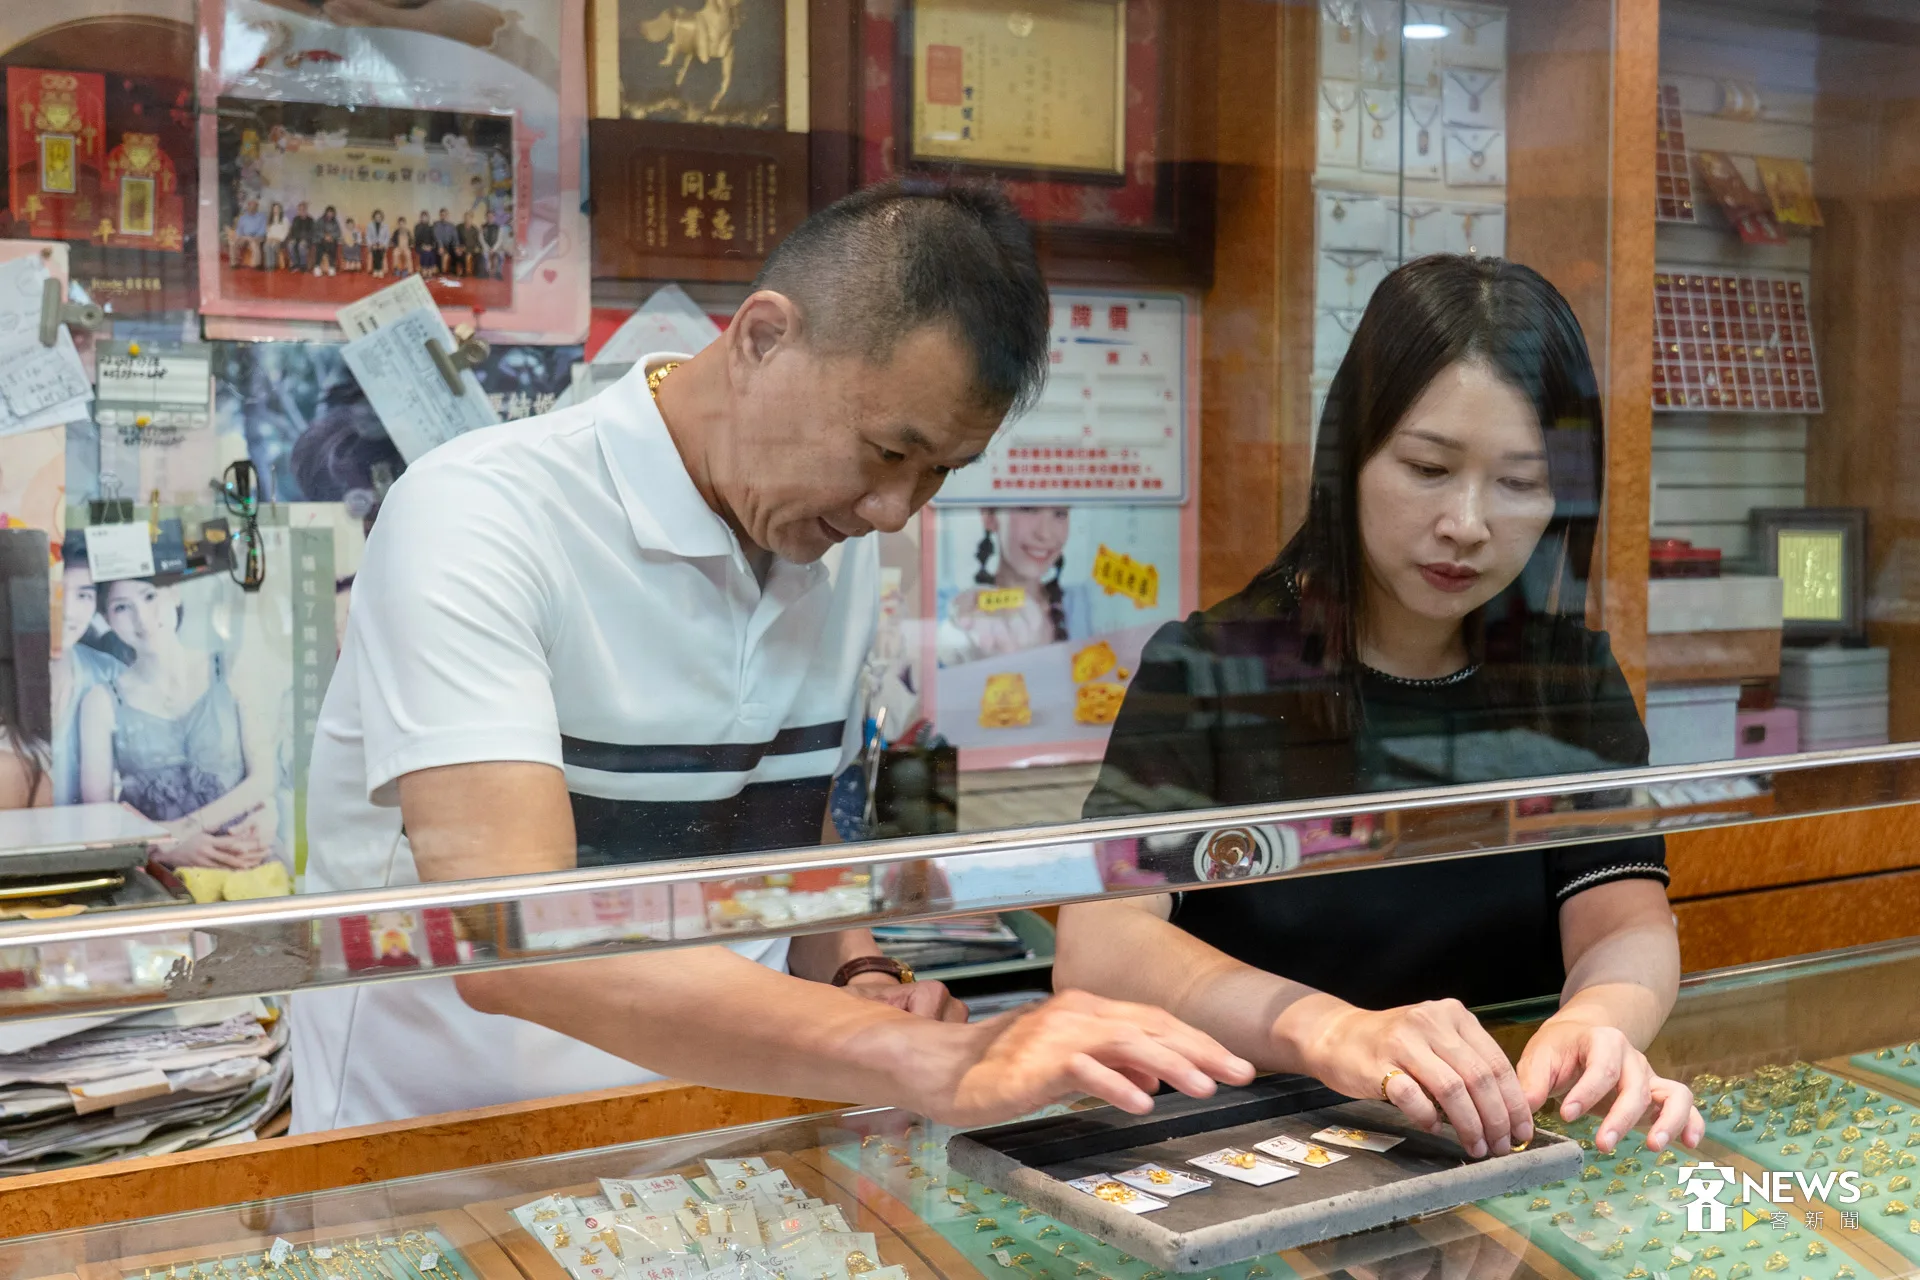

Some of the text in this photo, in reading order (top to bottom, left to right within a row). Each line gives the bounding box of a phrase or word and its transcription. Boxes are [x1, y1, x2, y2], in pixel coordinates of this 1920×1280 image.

[679, 169, 705, 240] 同業
[707, 169, 736, 241] 嘉惠
[1049, 304, 1129, 331] 牌價
[734, 1250, 752, 1262] YES
